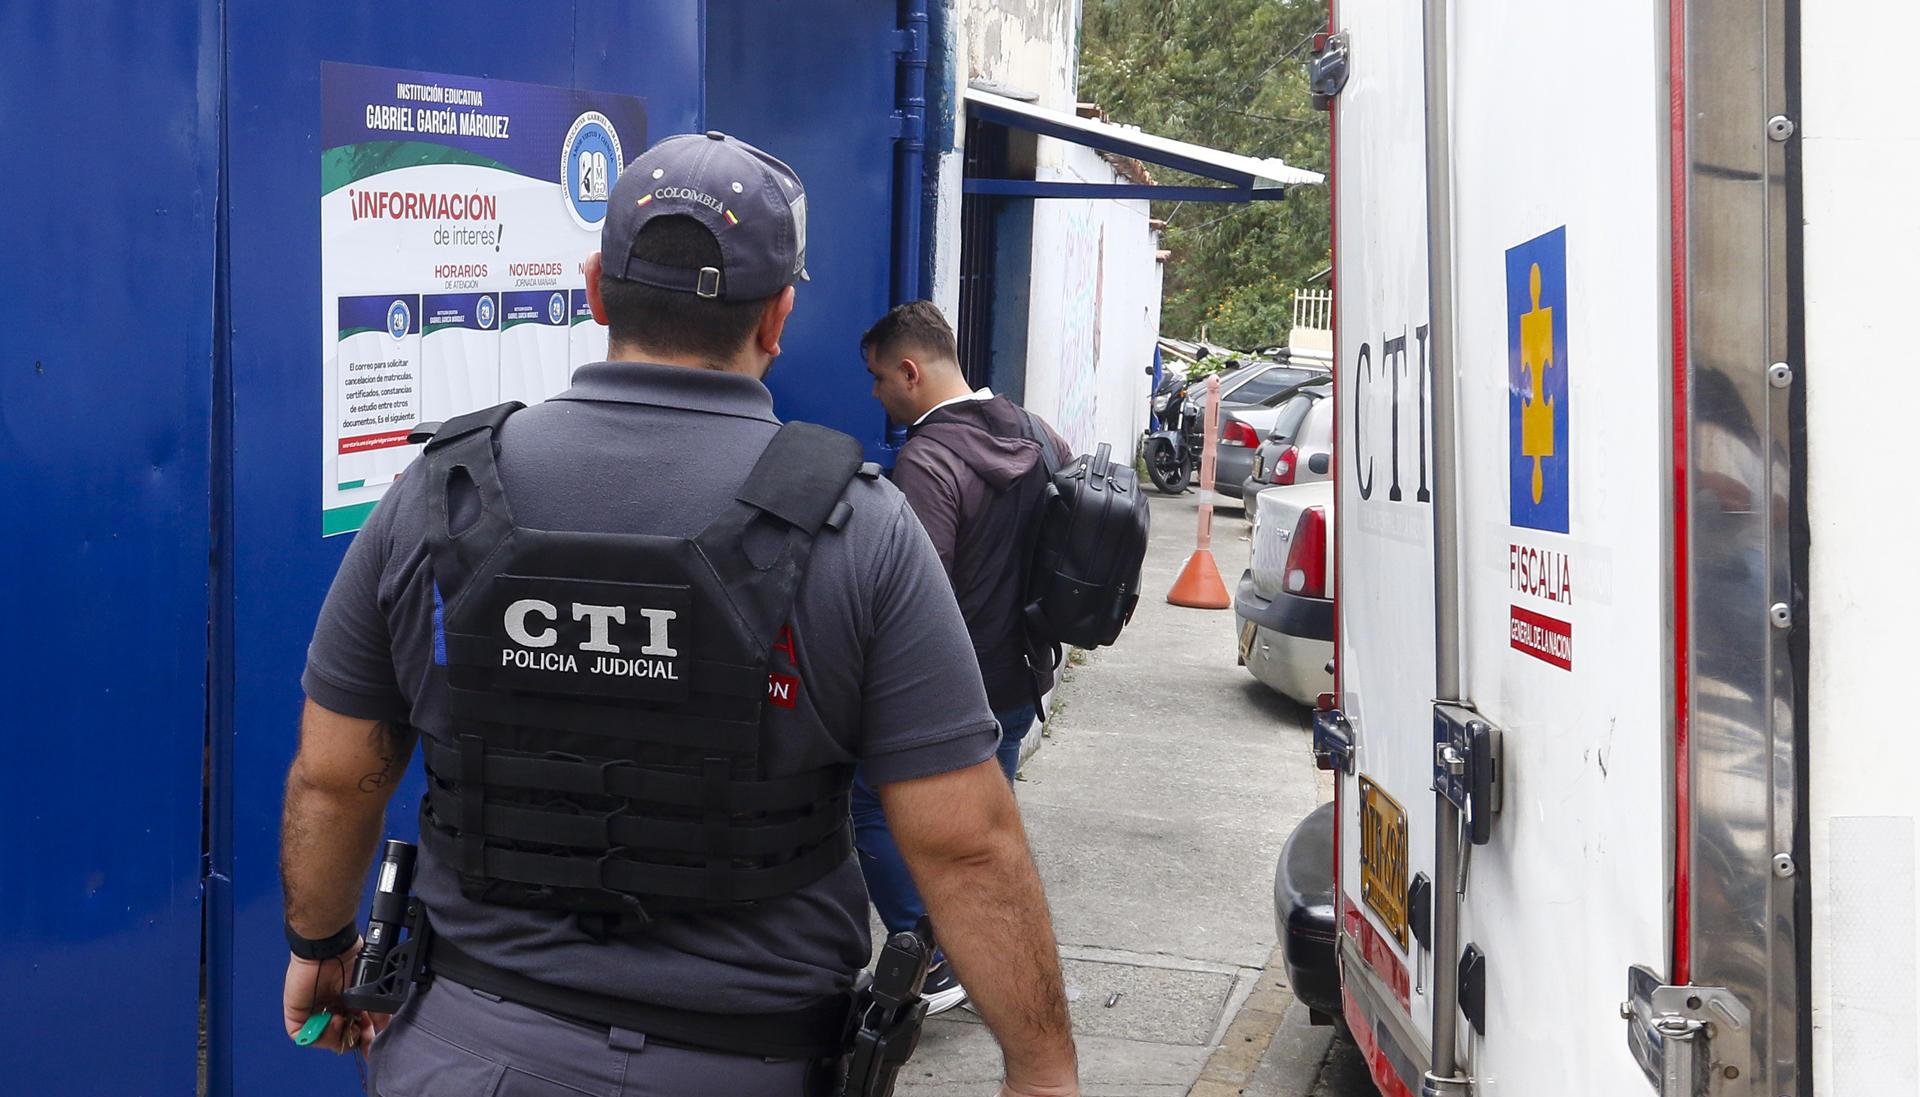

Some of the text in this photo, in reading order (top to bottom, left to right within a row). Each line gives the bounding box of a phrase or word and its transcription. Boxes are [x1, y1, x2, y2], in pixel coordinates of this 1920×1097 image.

[397, 83, 483, 107] INSTITUCIÓN EDUCATIVA
[366, 104, 510, 139] GABRIEL GARCÍA MÁRQUEZ
[349, 188, 497, 221] ¡INFORMACIÓN
[655, 186, 725, 215] COLOMBIA
[433, 225, 450, 246] de
[434, 264, 488, 278] HORARIOS
[509, 262, 562, 277] NOVEDADES
[445, 280, 453, 290] DE
[355, 363, 374, 371] correo
[374, 361, 386, 371] para
[387, 359, 408, 369] solicitar
[376, 373, 383, 383] de
[381, 385, 412, 397] constancias
[350, 400, 409, 413] de estudio entre otros
[1355, 323, 1430, 503] CTI
[377, 415, 384, 424] Es
[1510, 544, 1571, 605] FISCALIA
[504, 599, 678, 658] CTI
[502, 649, 679, 680] POLICIA JUDICIAL
